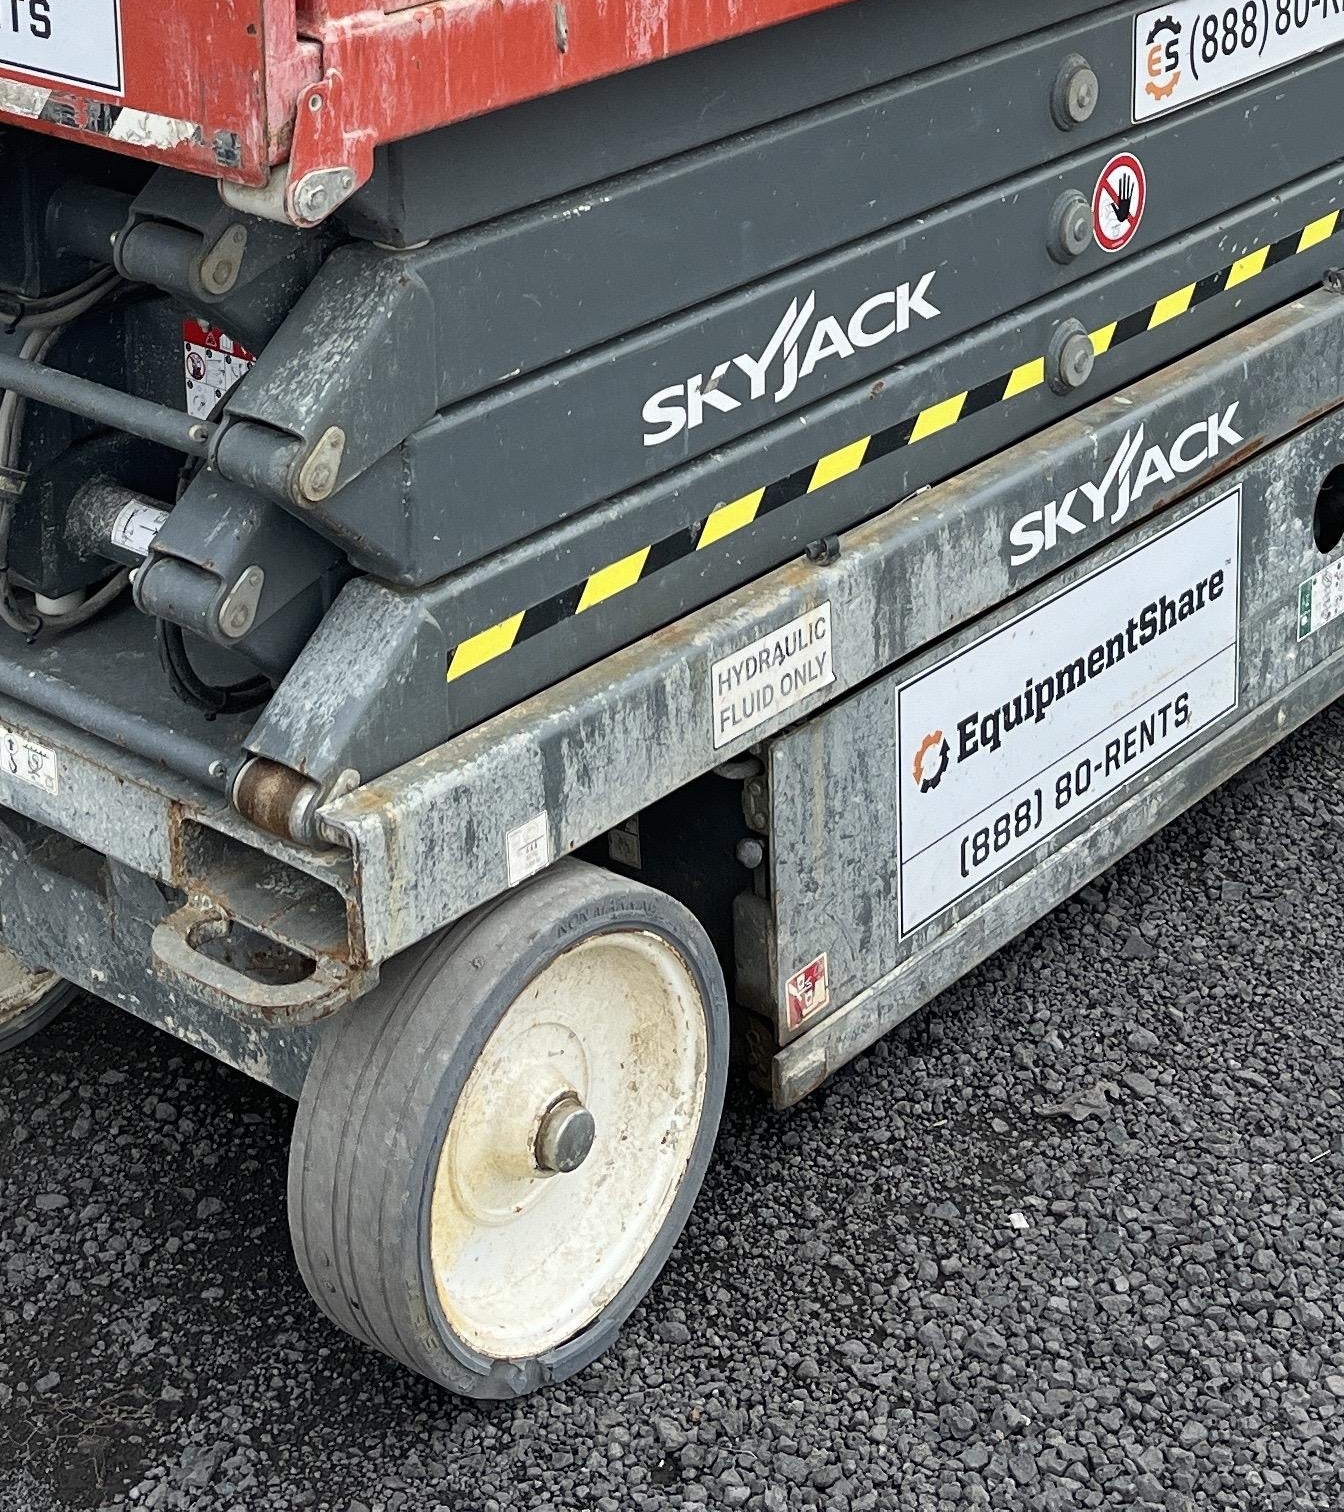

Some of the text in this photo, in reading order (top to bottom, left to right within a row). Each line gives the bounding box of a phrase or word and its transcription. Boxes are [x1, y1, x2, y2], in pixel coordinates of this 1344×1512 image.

[643, 271, 941, 446] SKYJACK
[1009, 400, 1244, 566] SKYJACK
[717, 616, 827, 697] HYDRAULIC
[719, 650, 828, 734] FLUID ONLY
[957, 568, 1225, 763] EquipmentShare
[960, 691, 1191, 878] (888) 80-RENTS
